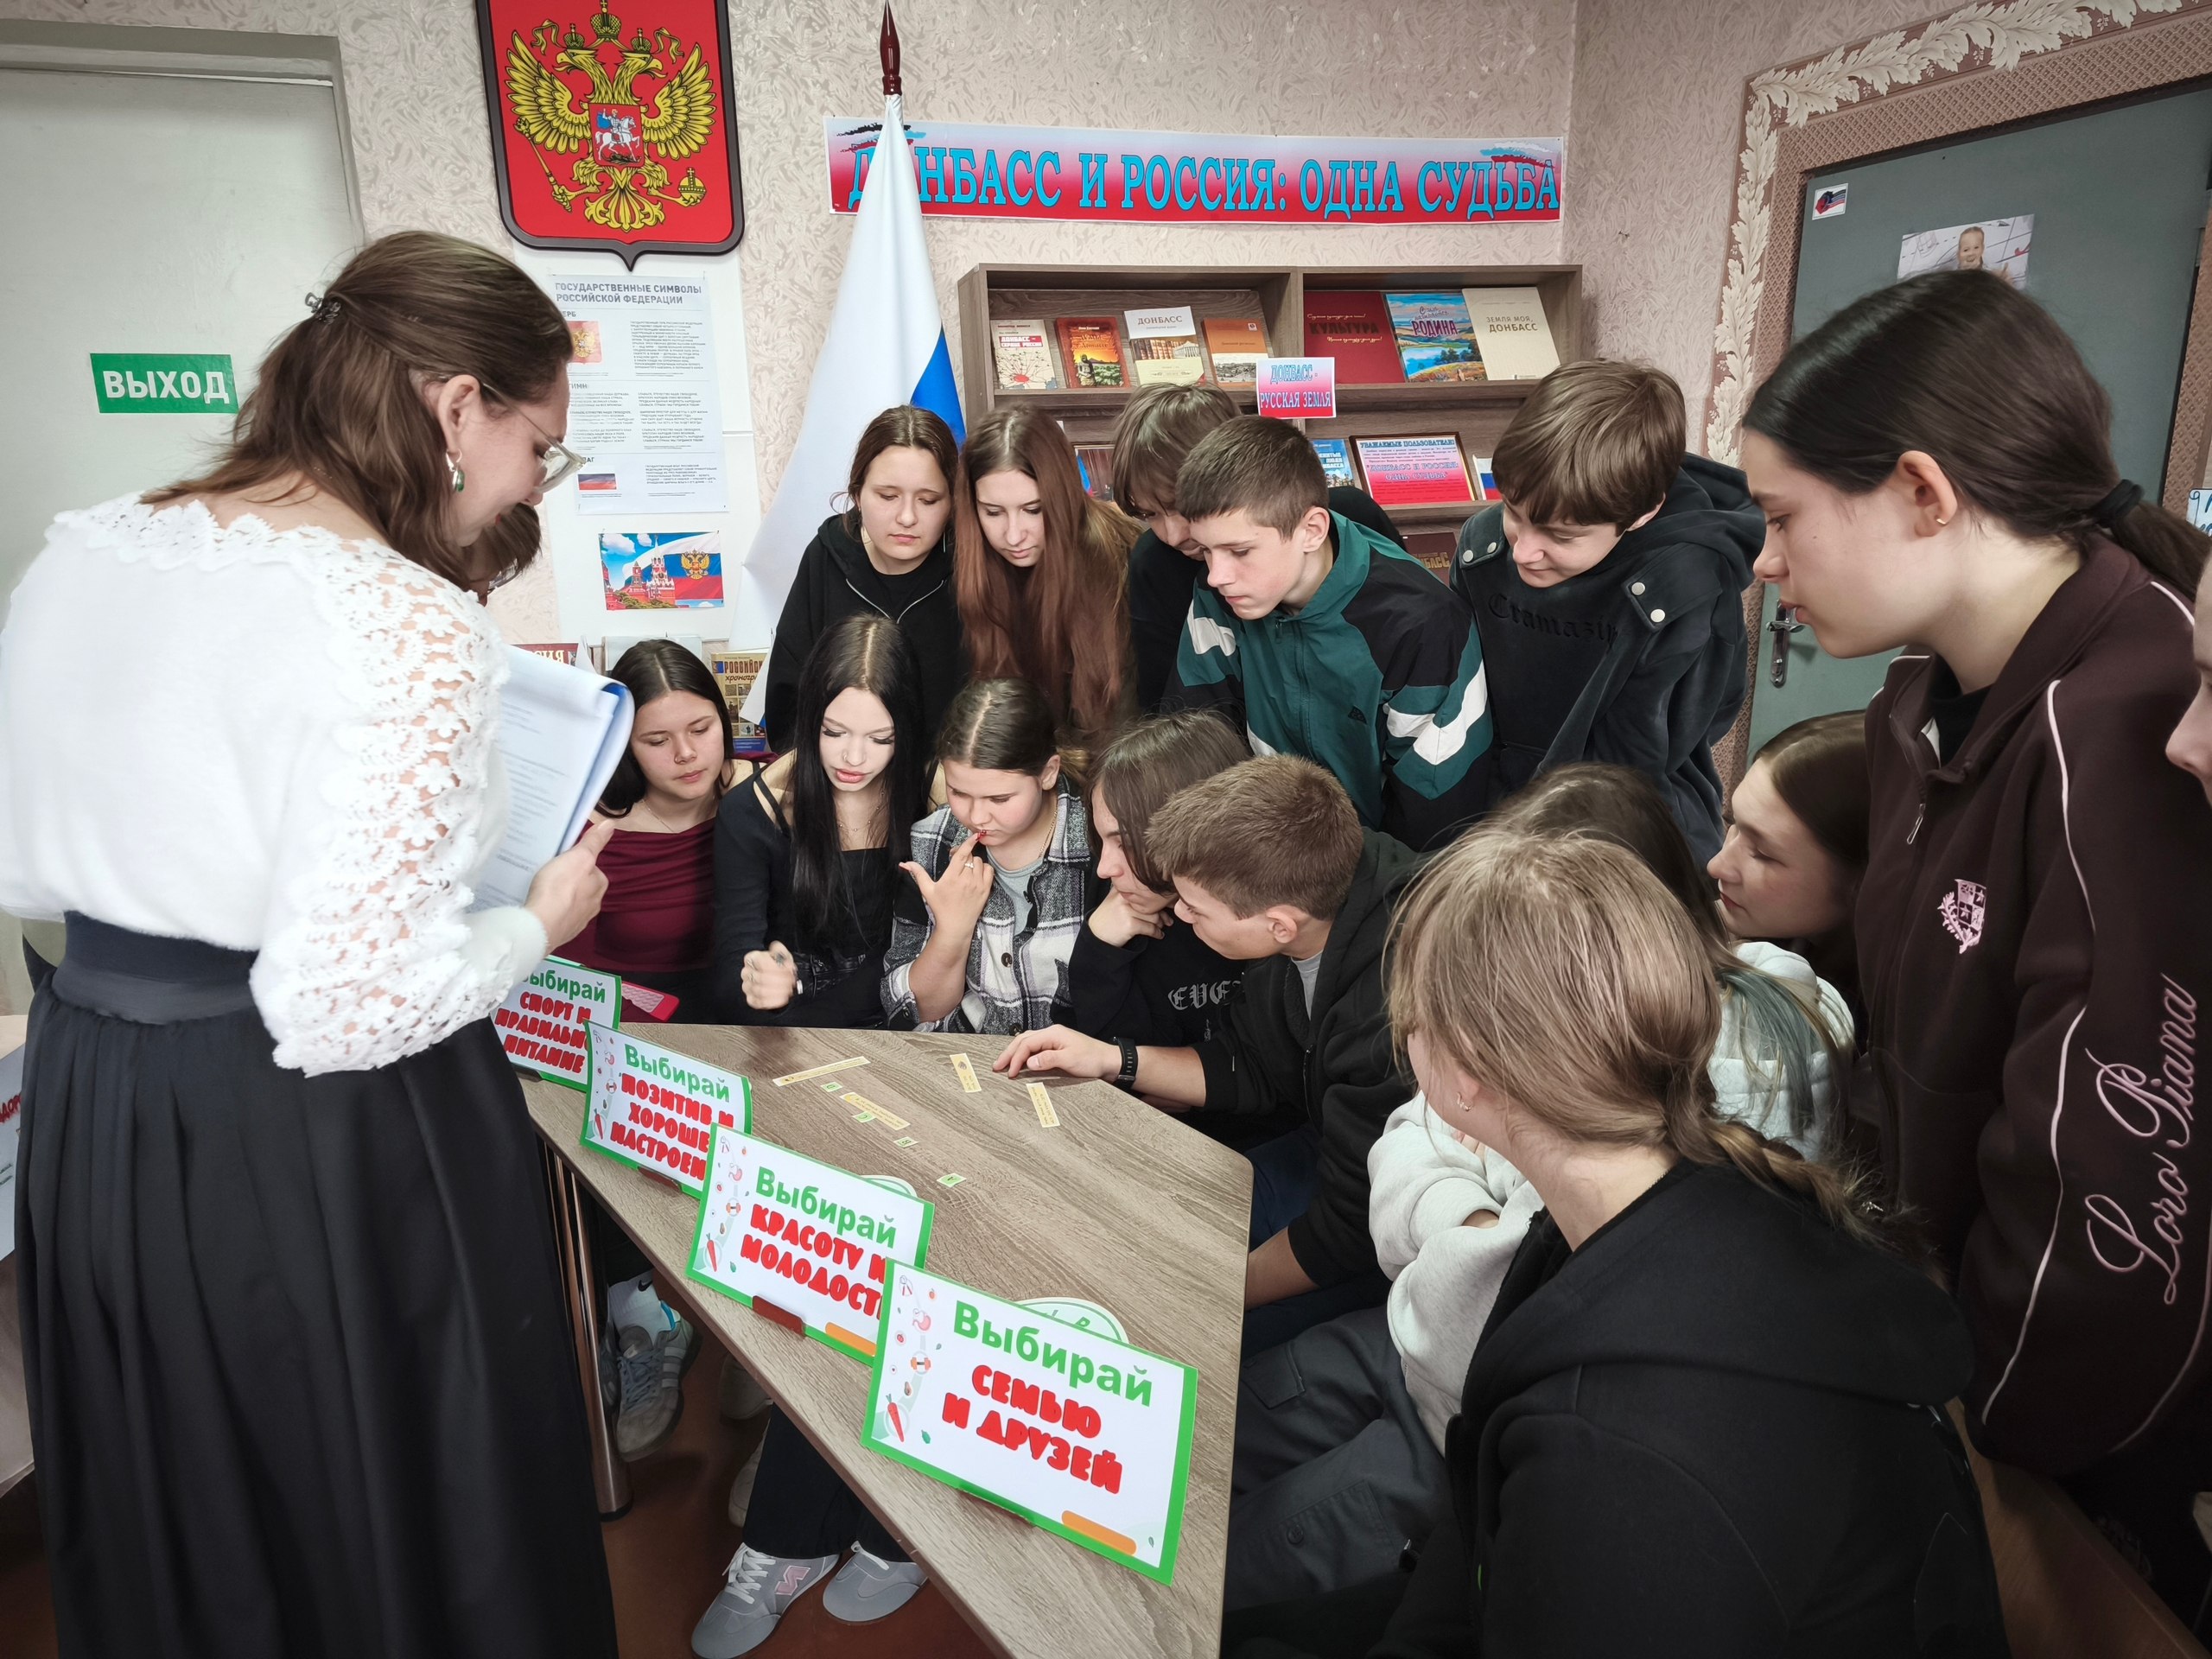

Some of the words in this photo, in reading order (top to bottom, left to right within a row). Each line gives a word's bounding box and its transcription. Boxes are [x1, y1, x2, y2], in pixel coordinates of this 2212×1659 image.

[848, 143, 1062, 210] ДНБАСС
[1079, 153, 1108, 207] И
[1121, 154, 1287, 211] РОССИЯ:
[1300, 159, 1404, 219] ОДНА
[1417, 159, 1560, 219] СУДЬБА
[555, 283, 652, 293] ГОСУДАРСТВЕННЫЕ
[653, 284, 702, 294] СИМВОЛЫ
[556, 293, 621, 303] РОССИЙСКОЙ
[623, 296, 683, 305] ФЕДЕРАЦИИ
[1137, 315, 1183, 325] ДОНБАСС
[1411, 320, 1458, 337] РОДИНА
[1489, 322, 1538, 333] ДОНБАСС
[103, 371, 230, 404] ВЫХОД
[1270, 364, 1313, 385] ДОНБАСС
[1259, 391, 1300, 409] РУССКАЯ
[1303, 391, 1332, 408] ЗЕМЛЯ
[1421, 552, 1452, 569] БАСС
[725, 659, 764, 673] РОССИЙС
[726, 674, 757, 683] хроногр
[523, 969, 606, 1003] ыбирай
[494, 1007, 588, 1052] ПРАВИЛЬН
[520, 991, 575, 1021] СПОРТ
[576, 1006, 591, 1025] И
[504, 1033, 585, 1074] ПИТАНИЕ
[625, 1043, 730, 1103] Выбирай
[2085, 972, 2197, 1150] Piana
[621, 1072, 713, 1125] ПОЗИТИВ
[718, 1110, 734, 1128] И
[628, 1102, 710, 1154] ХОРОШЕ
[610, 1122, 707, 1181] НАСТРОЕН
[756, 1166, 897, 1249] Выбирай
[2085, 1151, 2190, 1306] Loro
[750, 1203, 864, 1270] КРАСОТУ
[868, 1253, 887, 1285] И
[741, 1234, 884, 1320] МОЛОДОСТ
[953, 1299, 1154, 1408] Выбирай
[971, 1364, 1103, 1439] СЕМЬЮ
[942, 1391, 971, 1429] И
[976, 1408, 1124, 1495] ДРУЗЕЙ
